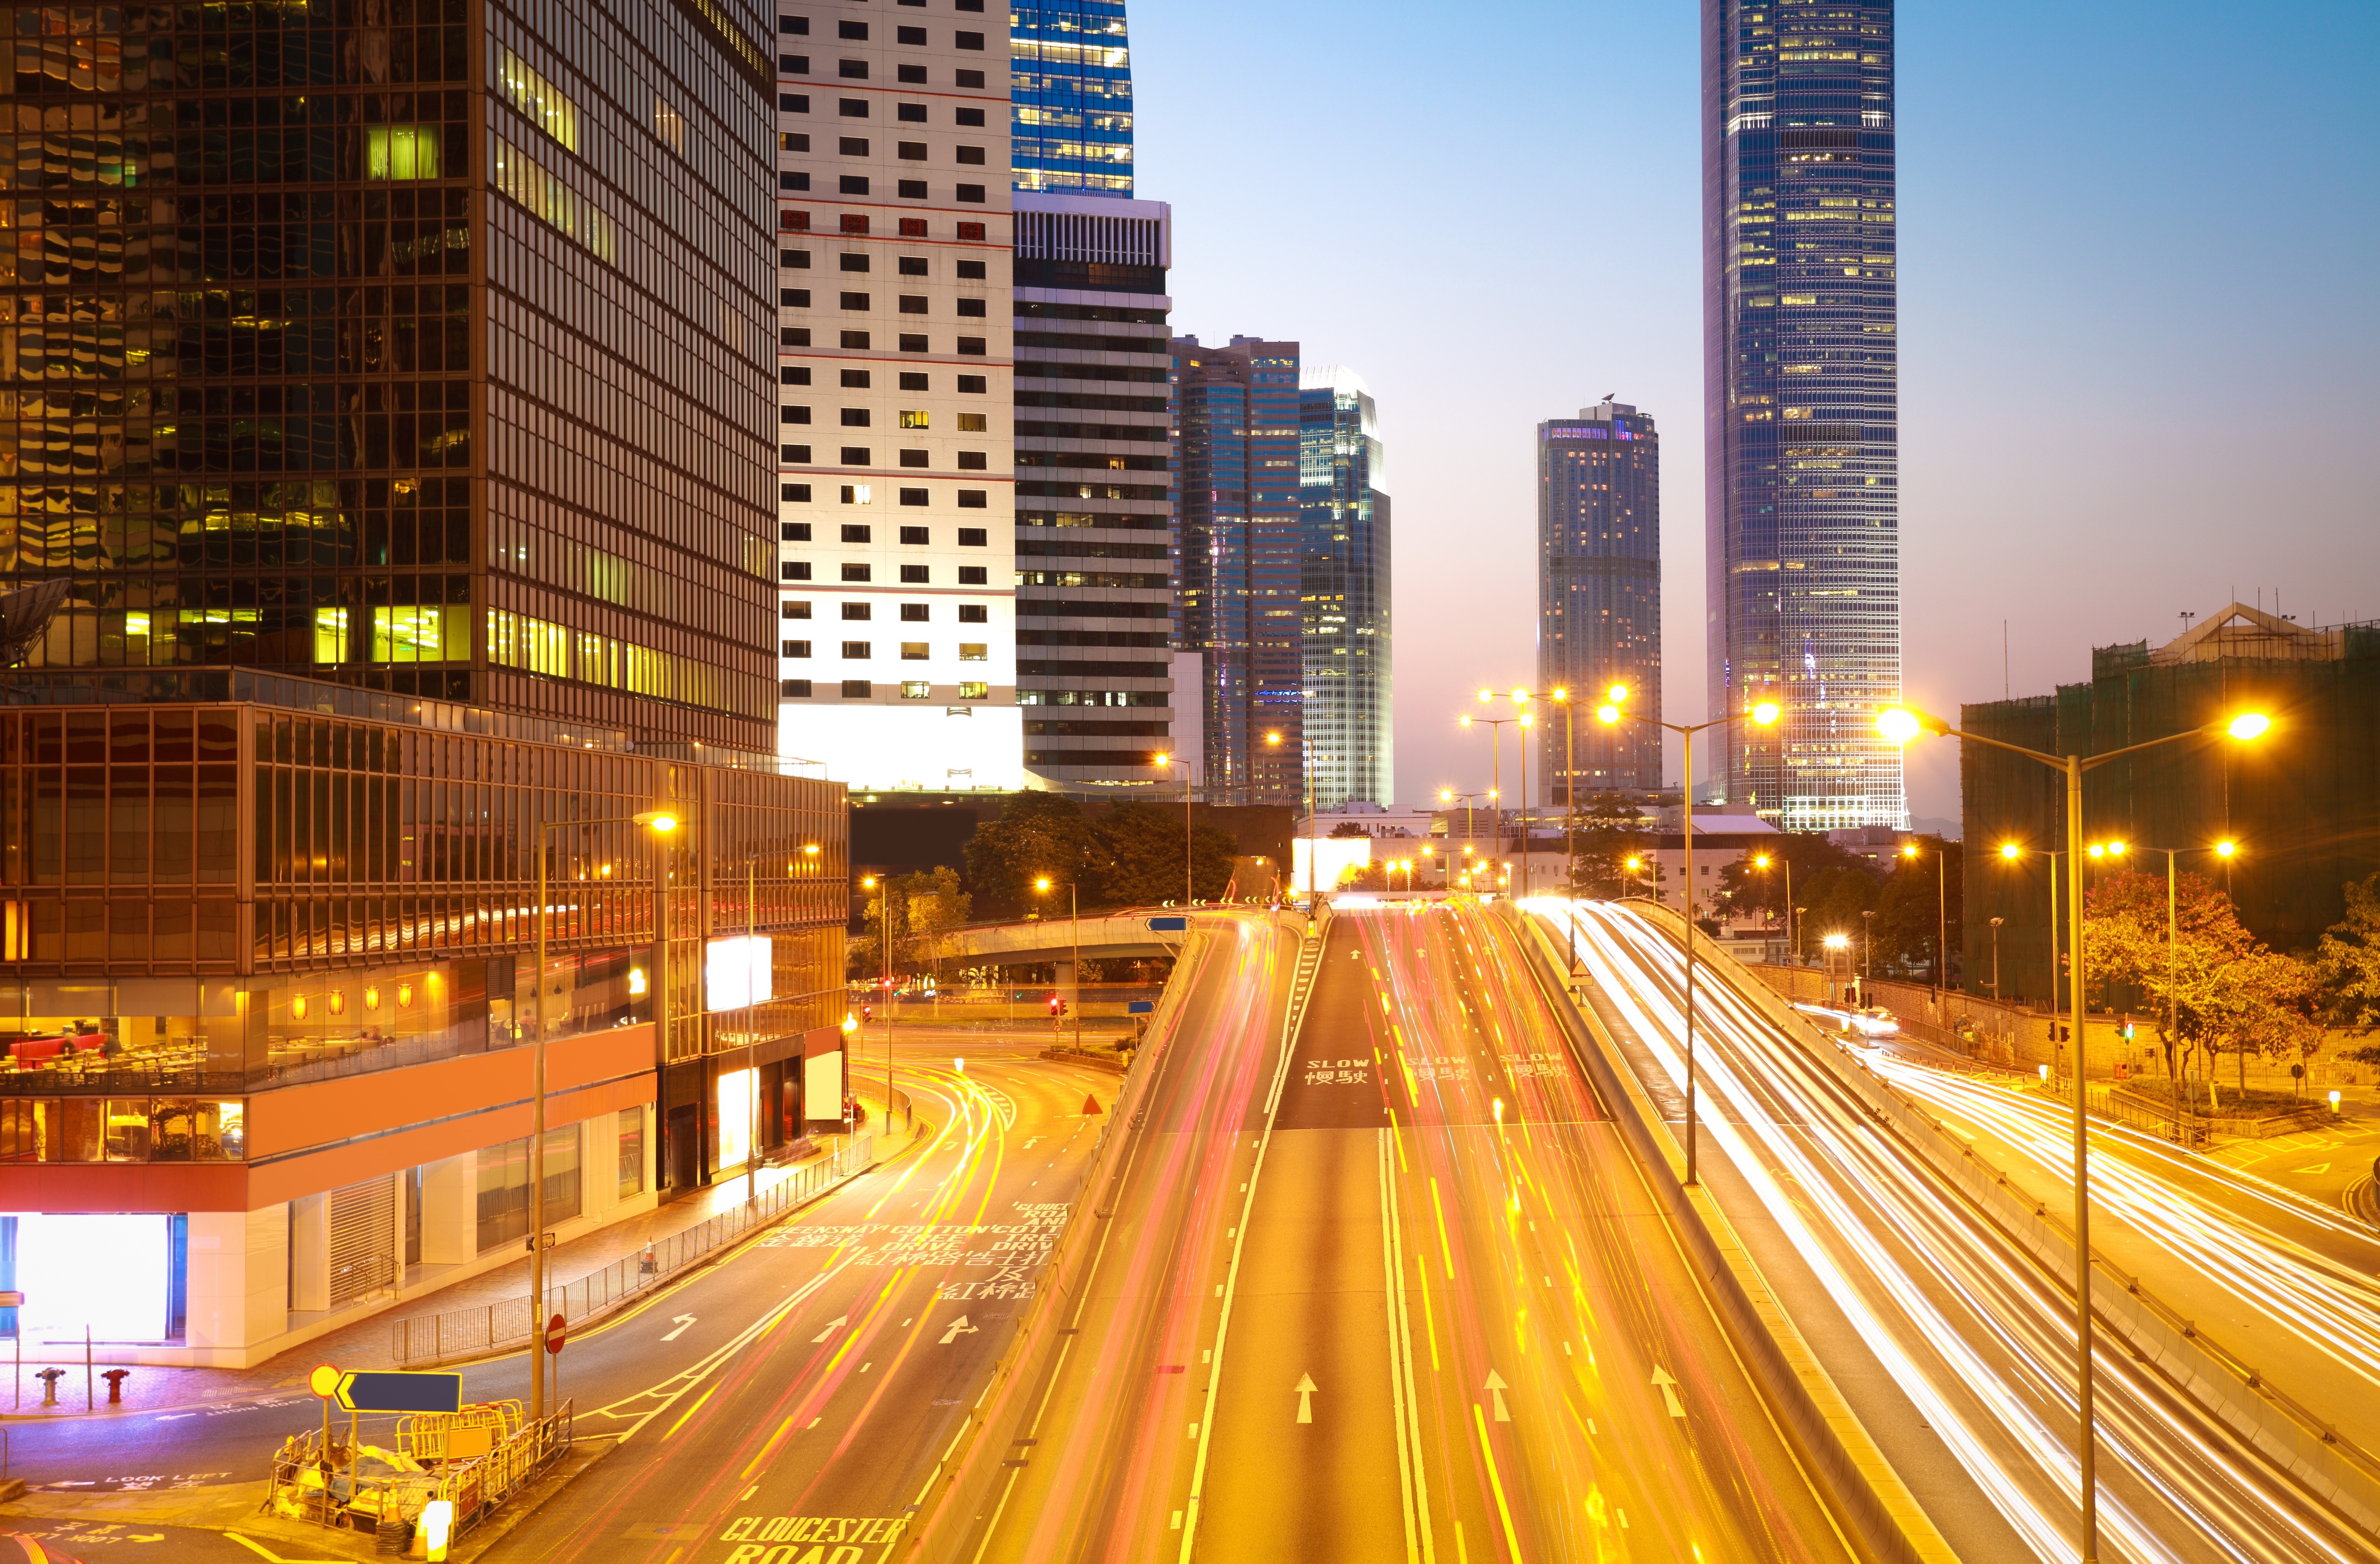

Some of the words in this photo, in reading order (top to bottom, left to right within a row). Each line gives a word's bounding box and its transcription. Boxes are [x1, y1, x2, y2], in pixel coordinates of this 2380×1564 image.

[1406, 1056, 1467, 1065] SLOW
[1500, 1053, 1562, 1061] SLOW
[1307, 1059, 1369, 1068] SLOW
[1305, 1070, 1368, 1085] 慢駛
[889, 1225, 990, 1234] COTTON
[753, 1234, 864, 1247] 金鐘道
[898, 1234, 968, 1242] TREE
[879, 1242, 966, 1251] DRIVE
[853, 1251, 965, 1265] 紅棉路
[985, 1266, 1031, 1282] 及
[264, 1398, 314, 1407] LOOK
[206, 1406, 259, 1416] RIGHT
[172, 1472, 233, 1480] LEFT
[720, 1517, 911, 1543] GLOUCESTER
[64, 1534, 122, 1544] LOOK
[723, 1544, 864, 1564] ROAD
